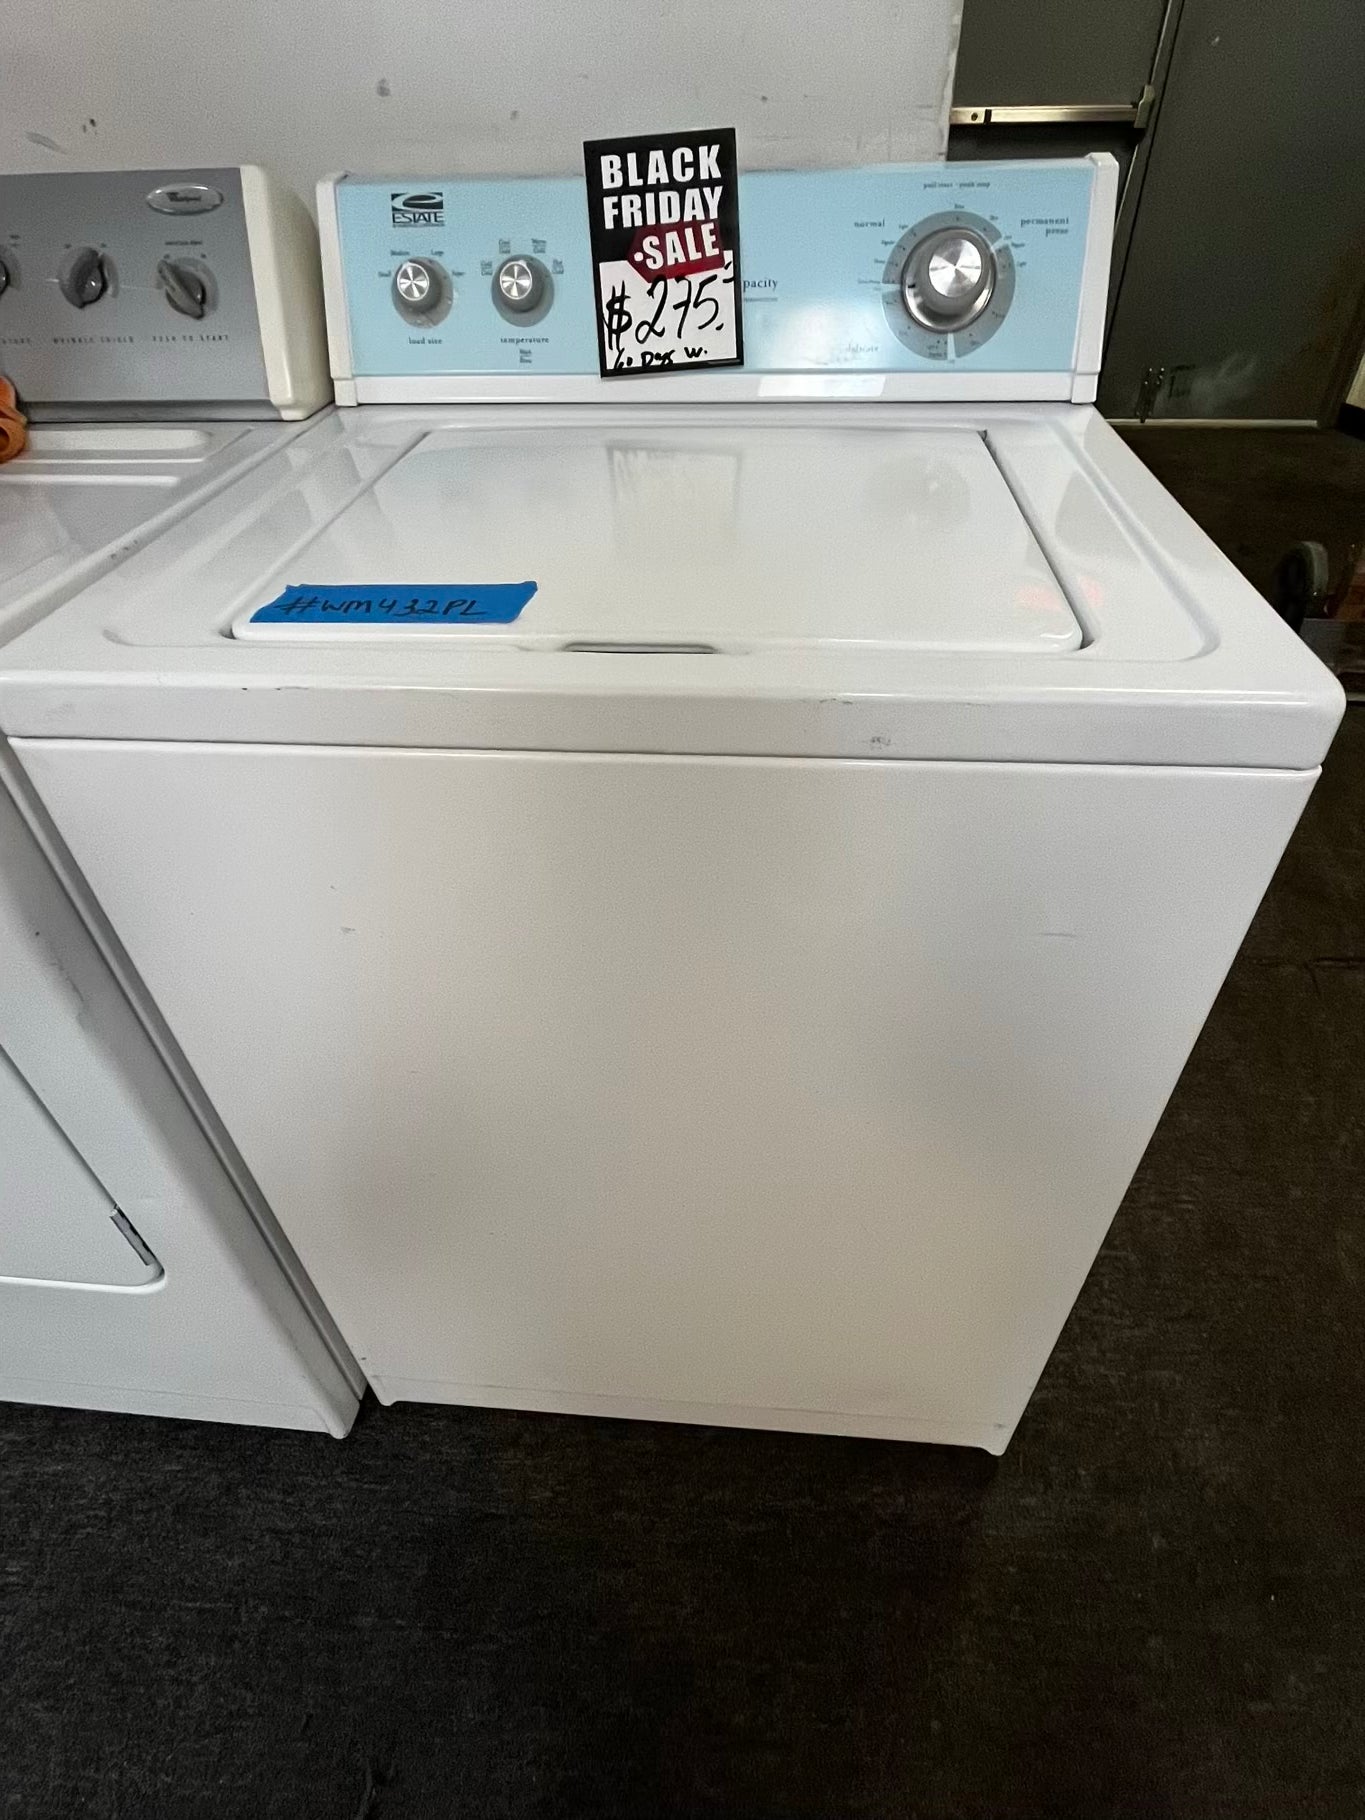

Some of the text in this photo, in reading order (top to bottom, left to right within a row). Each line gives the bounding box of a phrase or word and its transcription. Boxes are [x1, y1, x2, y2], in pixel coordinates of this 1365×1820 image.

[600, 144, 722, 190] BLACK
[602, 185, 724, 230] FRIDAY
[392, 211, 445, 224] ESTATE
[854, 217, 885, 227] normal
[1020, 216, 1069, 228] permanent
[642, 222, 720, 270] SALE
[743, 277, 778, 293] pacity
[500, 337, 550, 346] temperature
